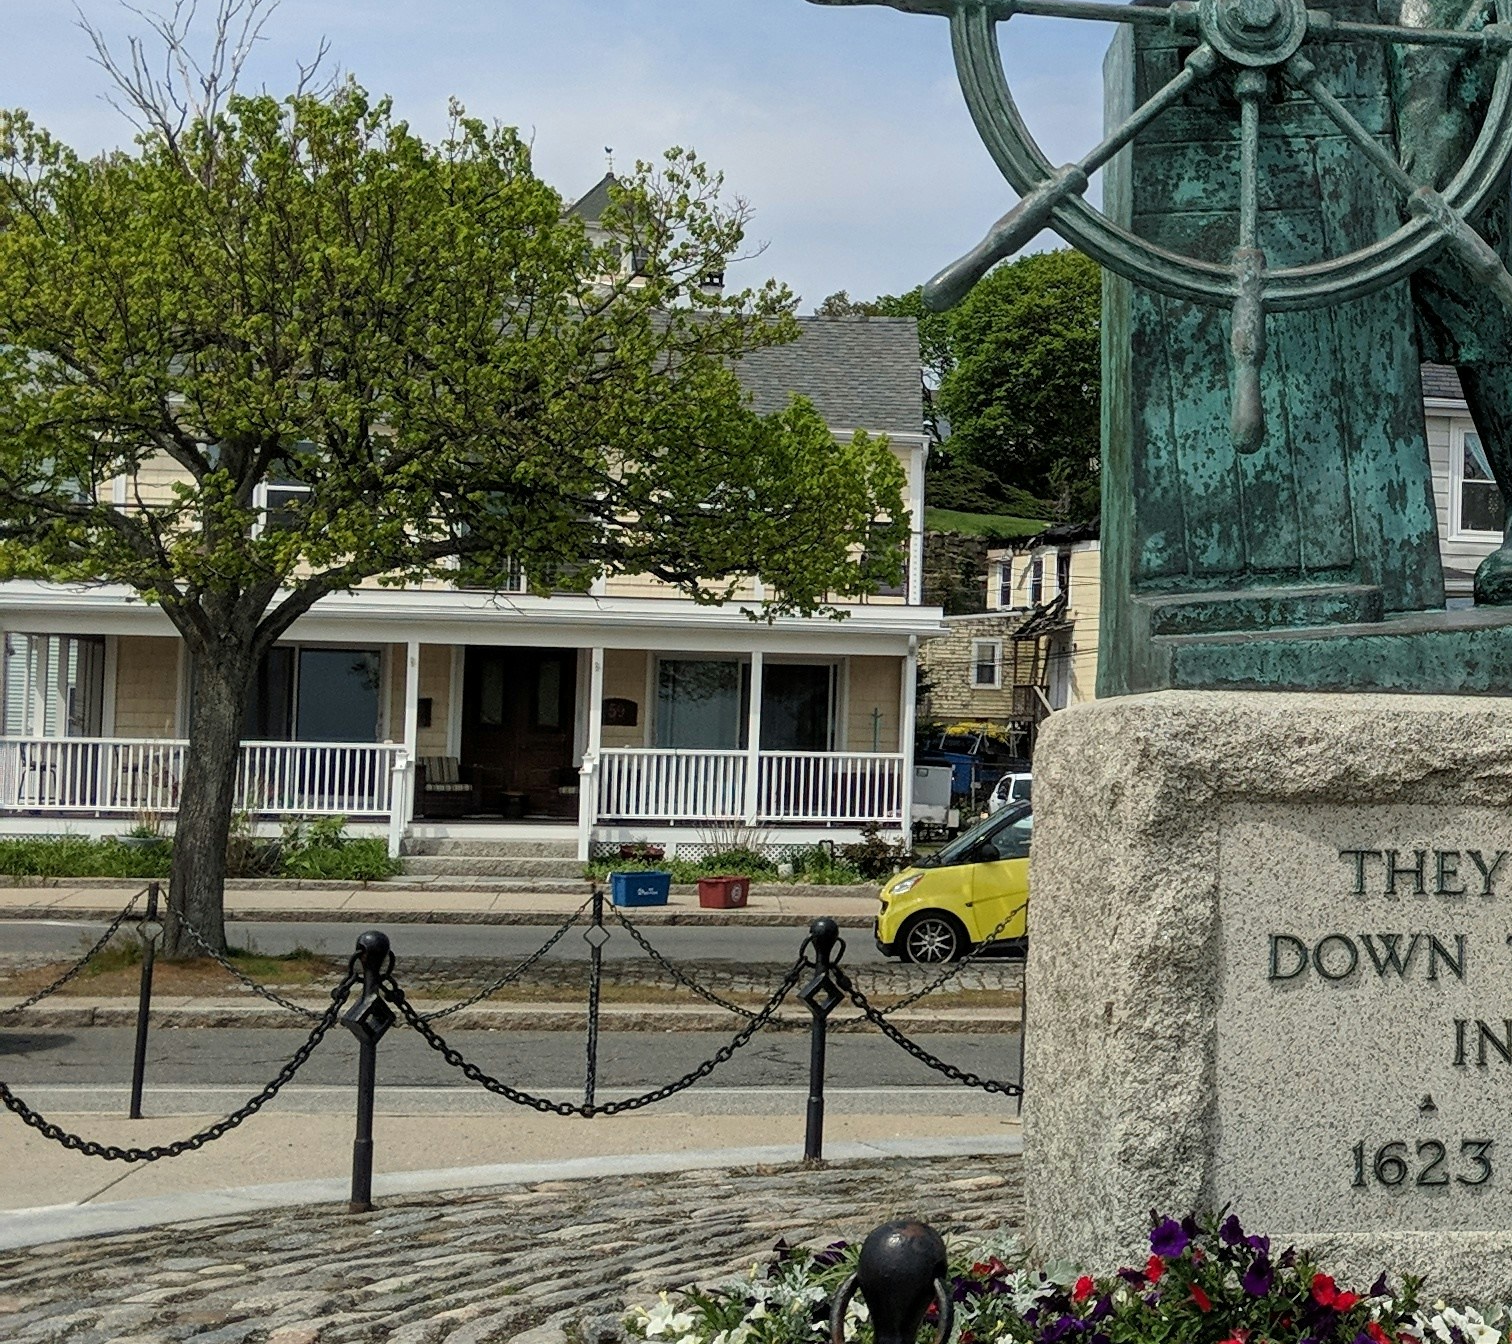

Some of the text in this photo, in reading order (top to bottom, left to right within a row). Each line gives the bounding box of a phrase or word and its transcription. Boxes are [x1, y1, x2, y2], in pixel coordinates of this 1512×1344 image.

[1339, 848, 1507, 898] THEY
[1267, 933, 1466, 983] DOWN
[1351, 1139, 1495, 1190] 1623
